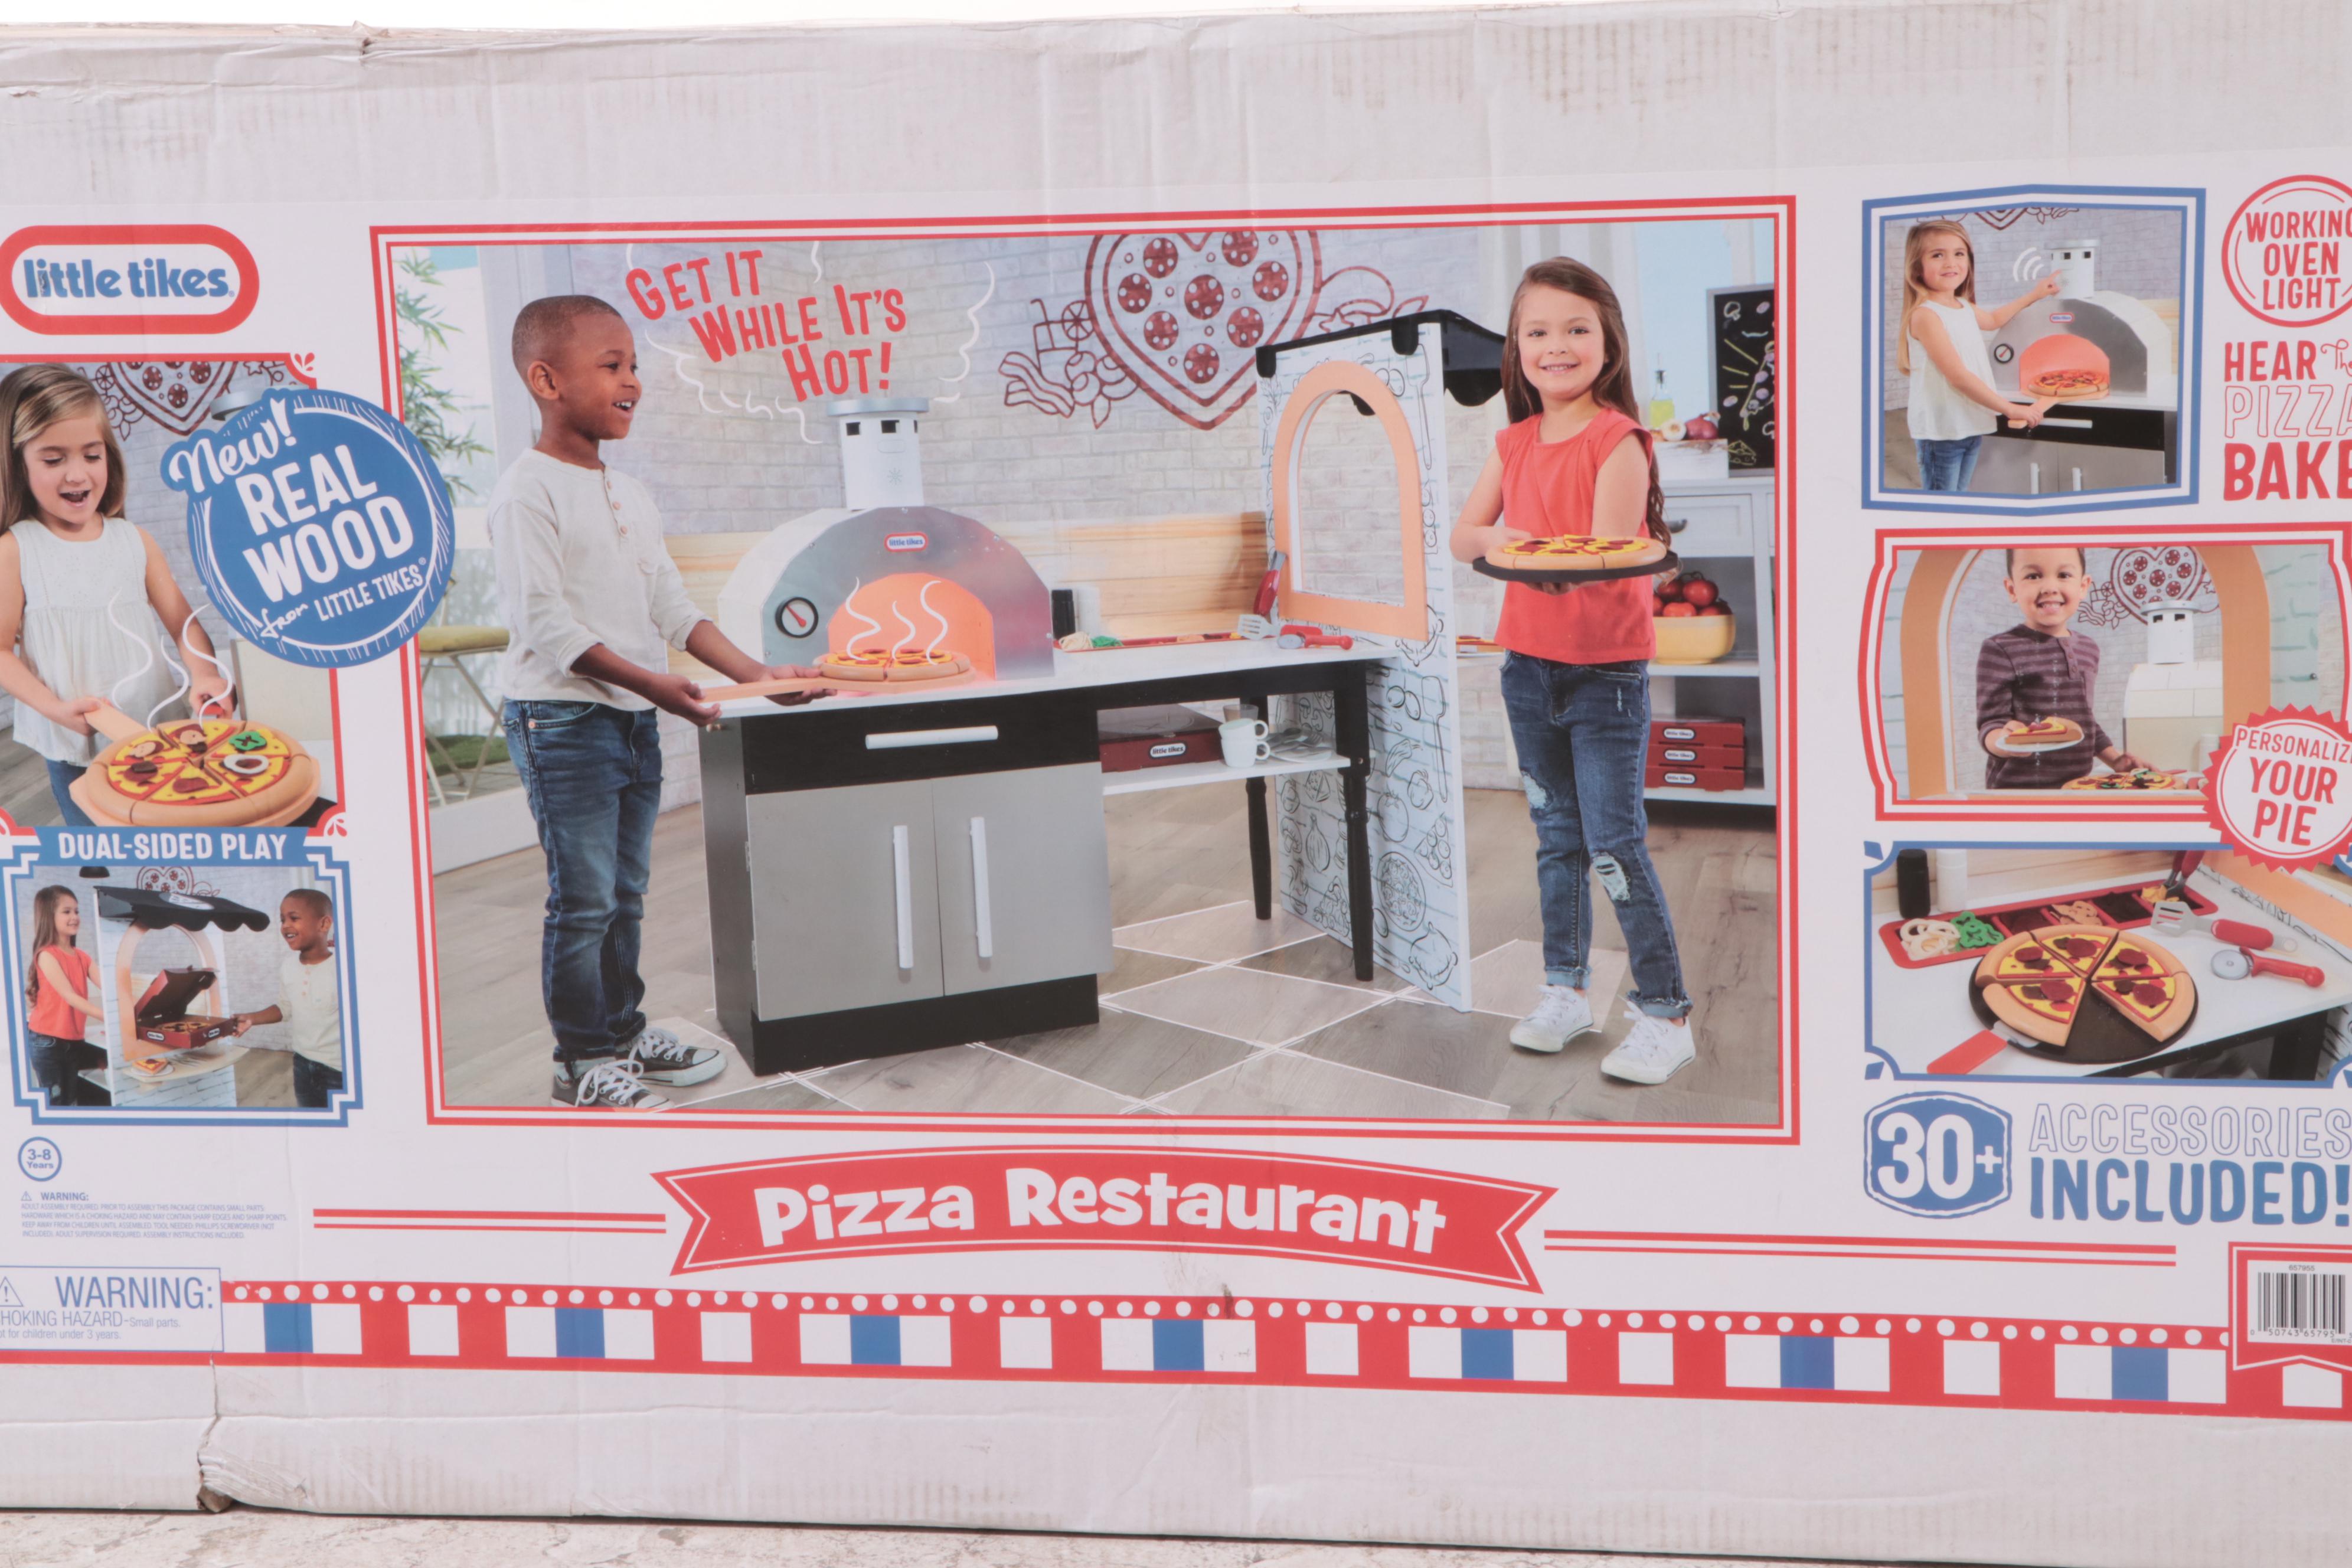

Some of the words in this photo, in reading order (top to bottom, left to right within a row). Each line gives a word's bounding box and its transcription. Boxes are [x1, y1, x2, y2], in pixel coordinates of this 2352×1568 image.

[24, 259, 122, 298] little
[2263, 241, 2339, 277] OVEN
[625, 257, 710, 321] GET
[725, 250, 763, 297] IT
[2263, 277, 2341, 310] LIGHT
[688, 297, 823, 362] WHILE
[832, 284, 907, 335] IT'S
[782, 342, 892, 402] HOT!
[2224, 340, 2317, 382] HEAR
[169, 397, 296, 493] New!
[236, 445, 377, 535] REAL
[243, 495, 414, 602] WOOD
[260, 603, 308, 638] from
[314, 582, 373, 621] LITTLE
[2236, 728, 2352, 764] PERSONALIZ
[2250, 757, 2337, 804] YOUR
[2253, 799, 2317, 846] PIE
[59, 833, 214, 860] DUAL-SIDED
[221, 834, 287, 860] PLAY
[28, 1149, 51, 1160] 3-8
[2028, 1103, 2351, 1160] ACCESSORIES
[1877, 1112, 2003, 1200] 30+
[41, 1192, 89, 1201] WARNING:
[753, 1182, 975, 1247] Pizza
[1004, 1167, 1446, 1255] Restaurant
[2029, 1157, 2350, 1227] INCLUDED!
[55, 1276, 213, 1308] WARNING:
[0, 1311, 57, 1326] HOKING
[156, 1318, 181, 1329] parts.
[8, 1329, 21, 1338] for
[22, 1329, 57, 1339] children
[59, 1330, 84, 1339] under
[87, 1330, 93, 1339] 3
[95, 1331, 121, 1341] years.
